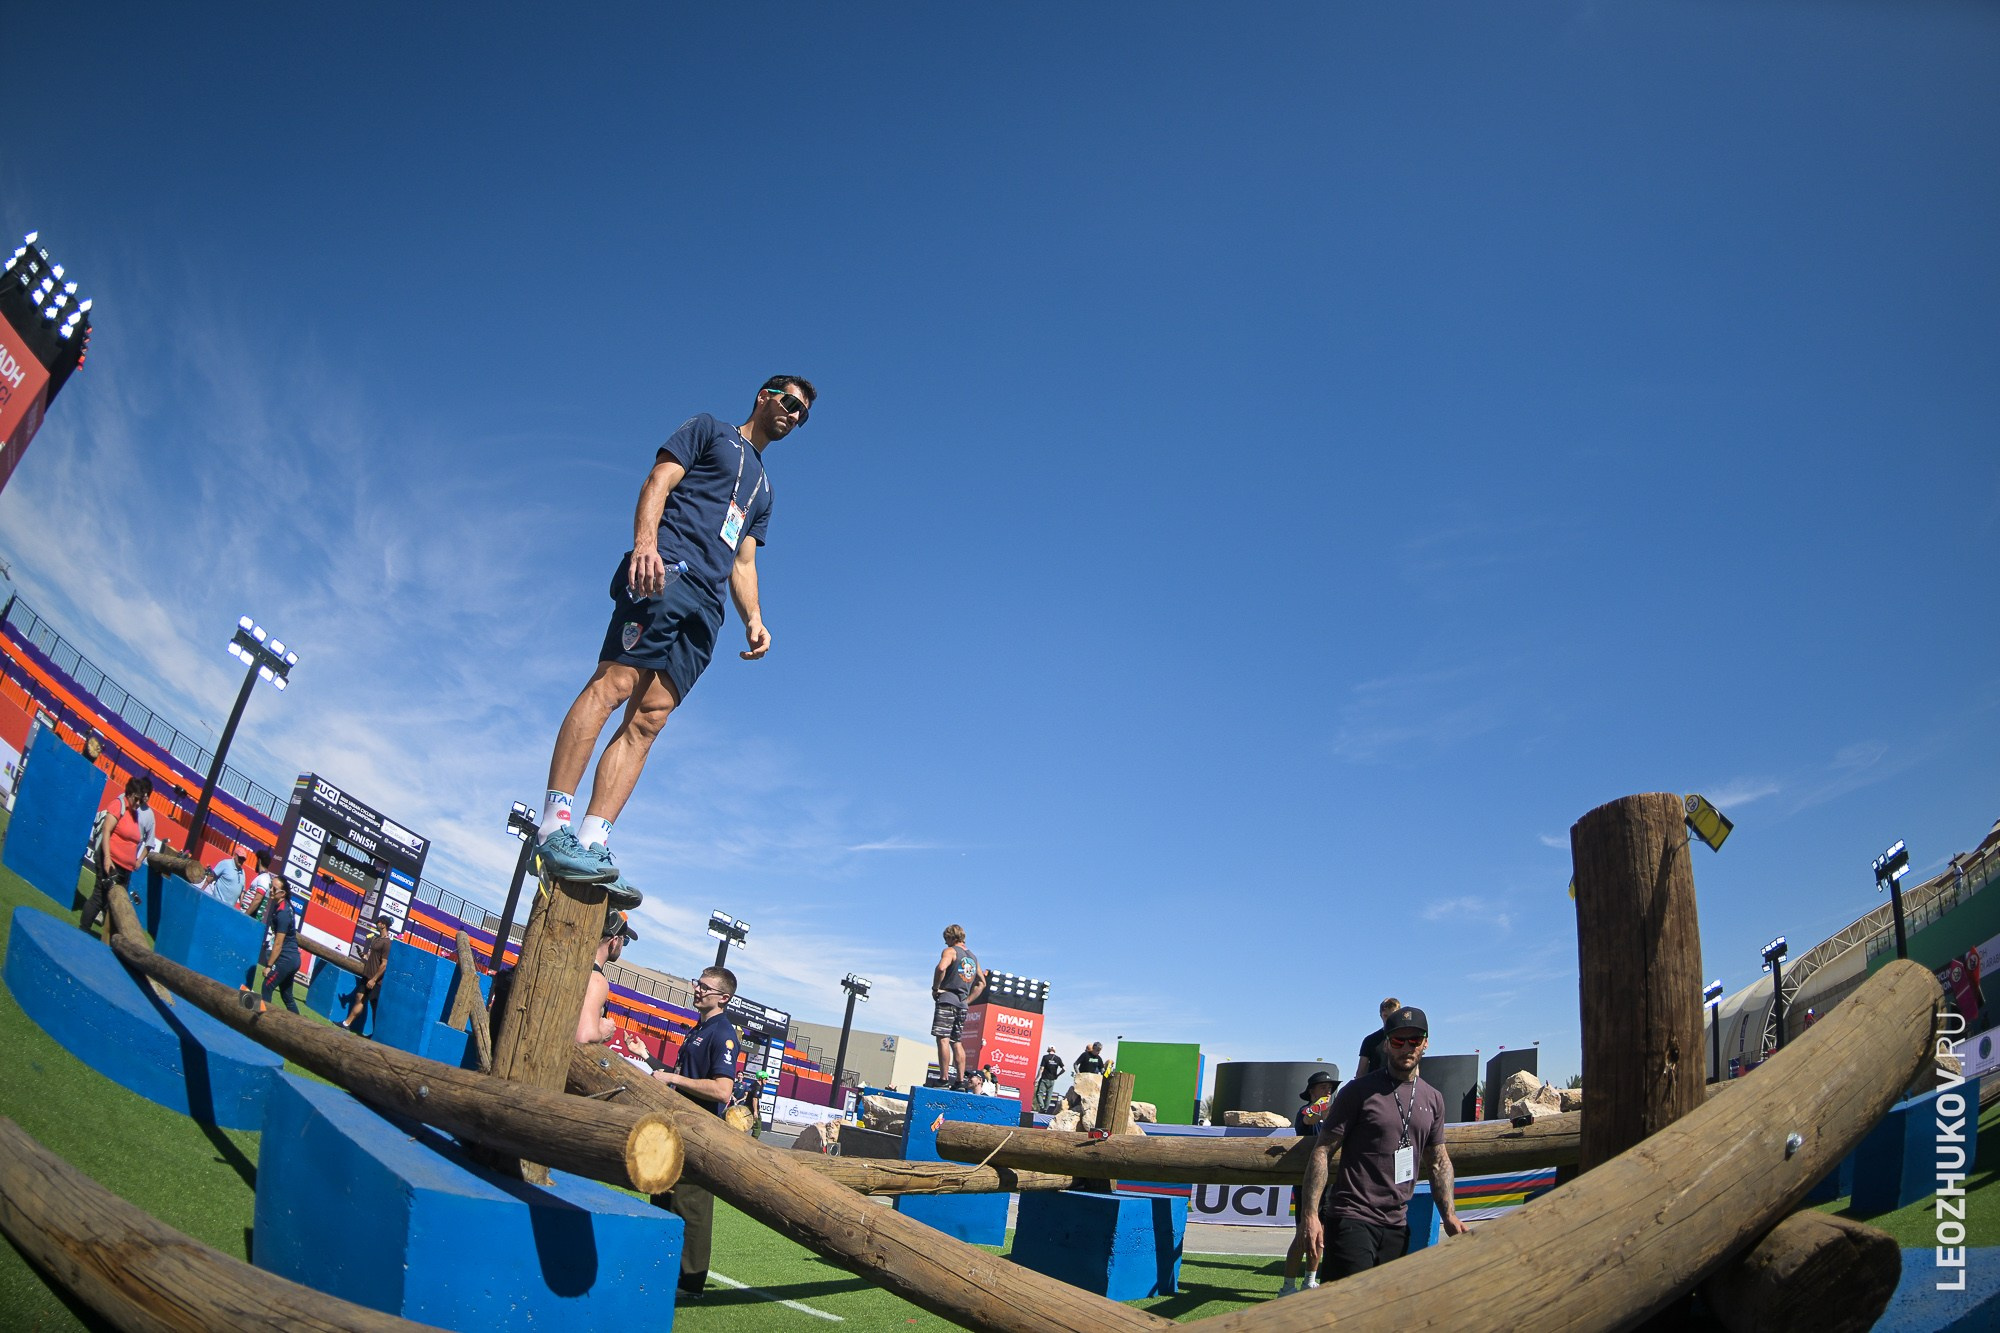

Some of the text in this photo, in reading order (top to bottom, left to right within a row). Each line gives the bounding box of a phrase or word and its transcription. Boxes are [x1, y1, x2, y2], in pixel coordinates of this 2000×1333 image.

[0, 344, 26, 389] ADH
[319, 783, 338, 801] UCI
[303, 822, 323, 839] UCI
[348, 829, 378, 851] FINISH
[293, 854, 312, 868] TISSOT
[390, 871, 415, 887] SHIMANO
[385, 902, 403, 915] TISSOT
[997, 1013, 1034, 1029] RIYADH
[996, 1024, 1032, 1038] 2025 UCI
[1195, 1184, 1280, 1216] UCI
